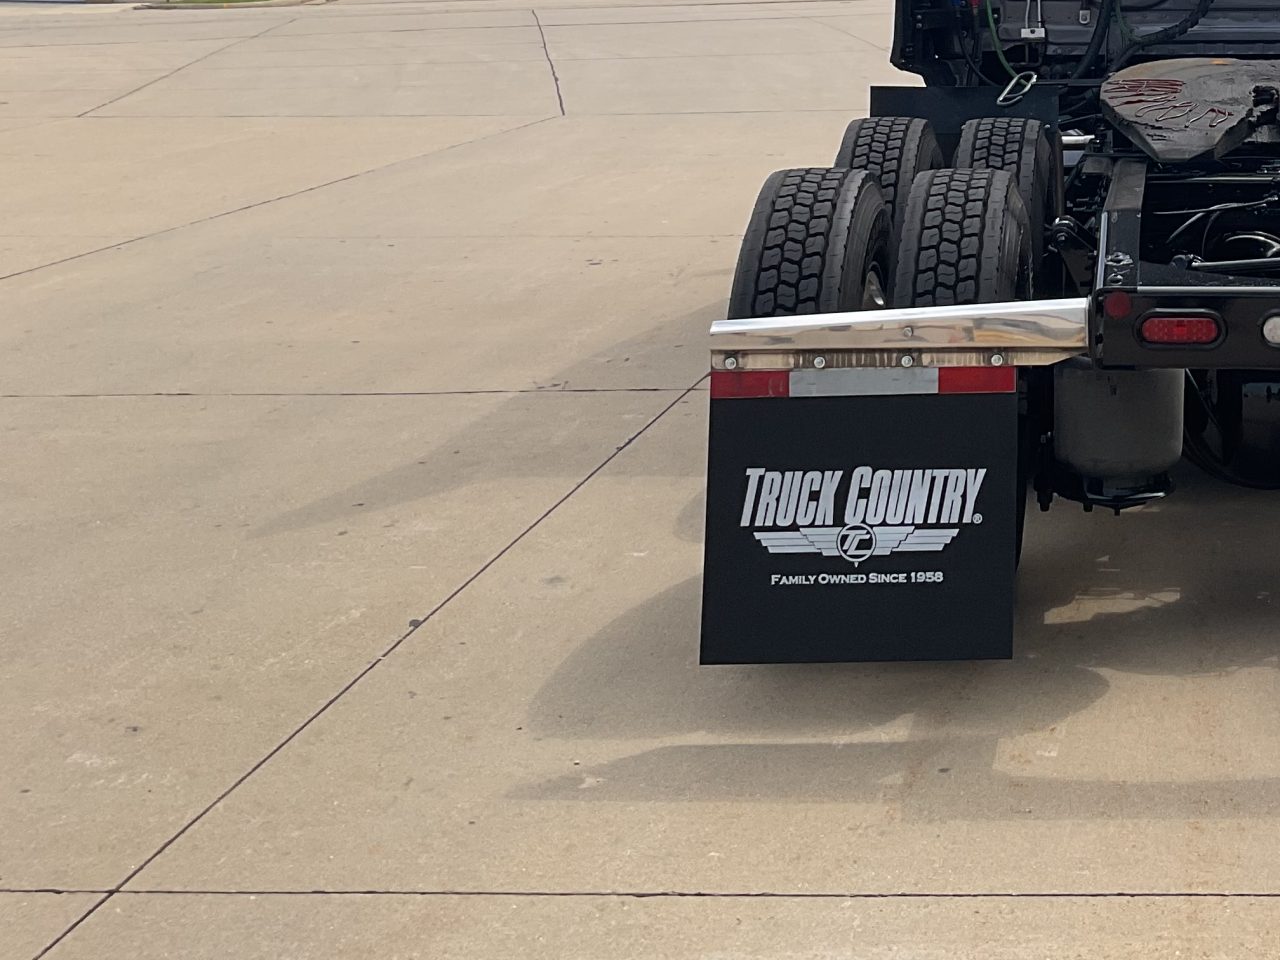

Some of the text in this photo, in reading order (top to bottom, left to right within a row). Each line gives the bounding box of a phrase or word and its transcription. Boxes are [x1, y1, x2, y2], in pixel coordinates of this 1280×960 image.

[740, 467, 843, 527] TRUCK
[840, 529, 871, 556] TC
[771, 571, 944, 586] FAMILY OWNED SINCE 1958
